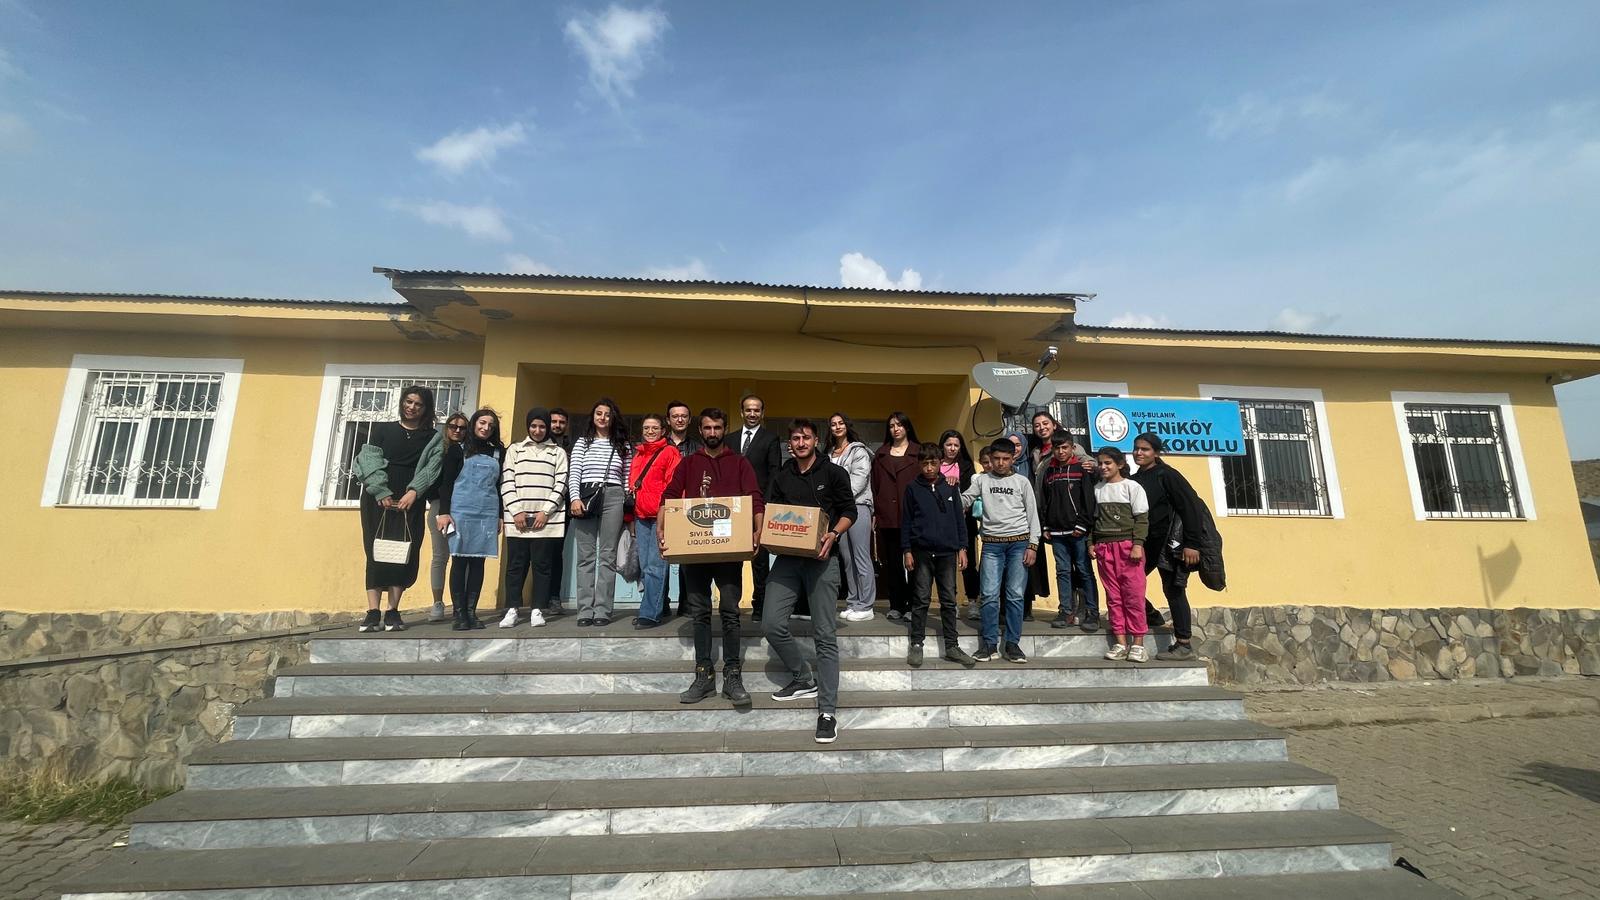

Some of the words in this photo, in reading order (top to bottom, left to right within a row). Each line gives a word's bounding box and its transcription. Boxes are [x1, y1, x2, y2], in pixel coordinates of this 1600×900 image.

[1160, 438, 1238, 452] KOKULU
[990, 487, 1013, 495] VERSACE
[692, 509, 727, 519] DURU
